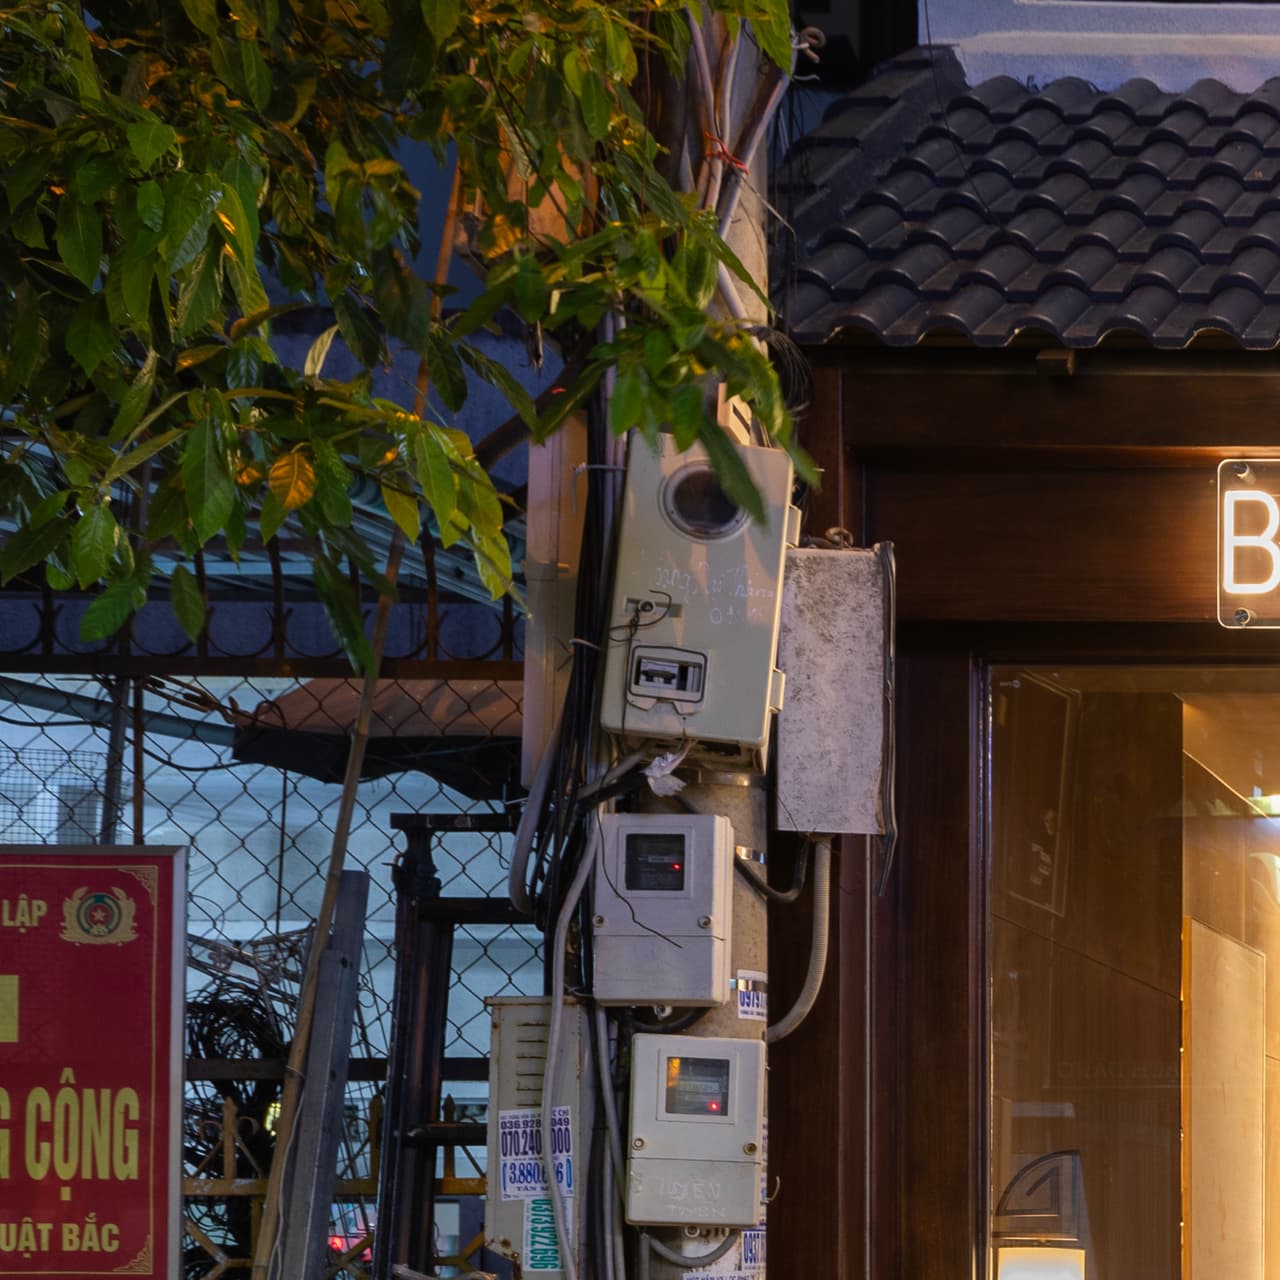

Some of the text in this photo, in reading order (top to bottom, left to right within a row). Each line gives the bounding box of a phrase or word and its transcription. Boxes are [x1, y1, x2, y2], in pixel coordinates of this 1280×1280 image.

[2, 895, 47, 934] LẬP
[25, 1067, 140, 1200] CỘNG
[62, 1212, 121, 1252] BẮC
